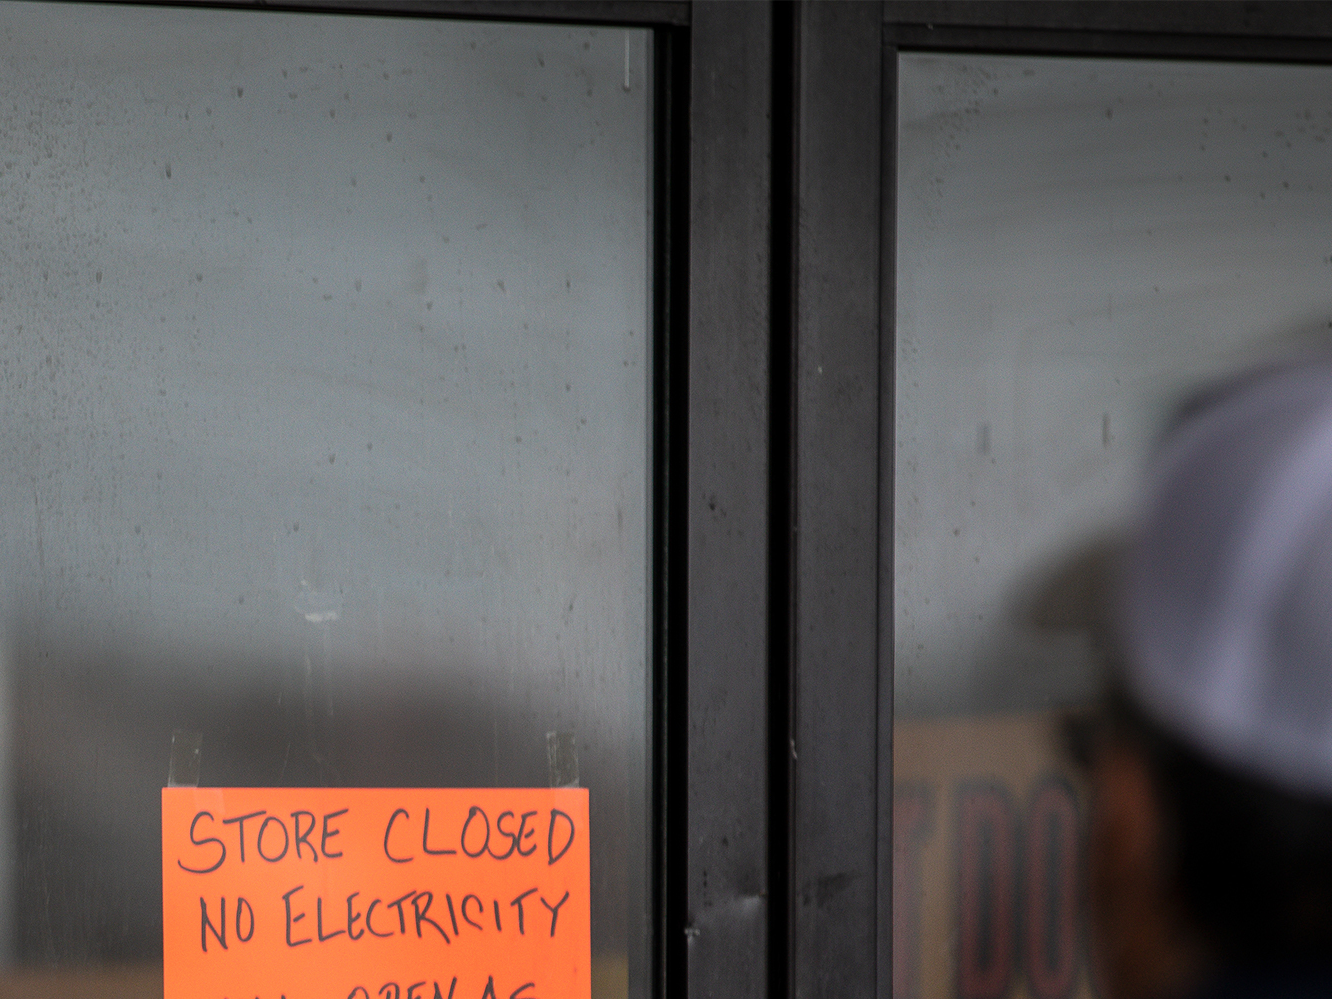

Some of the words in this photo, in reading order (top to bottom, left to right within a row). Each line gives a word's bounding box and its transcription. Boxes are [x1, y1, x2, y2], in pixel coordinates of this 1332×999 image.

[178, 808, 349, 873] STORE
[384, 806, 575, 865] CLOSED
[199, 896, 255, 952] NO
[282, 885, 569, 947] ELECTRICITY
